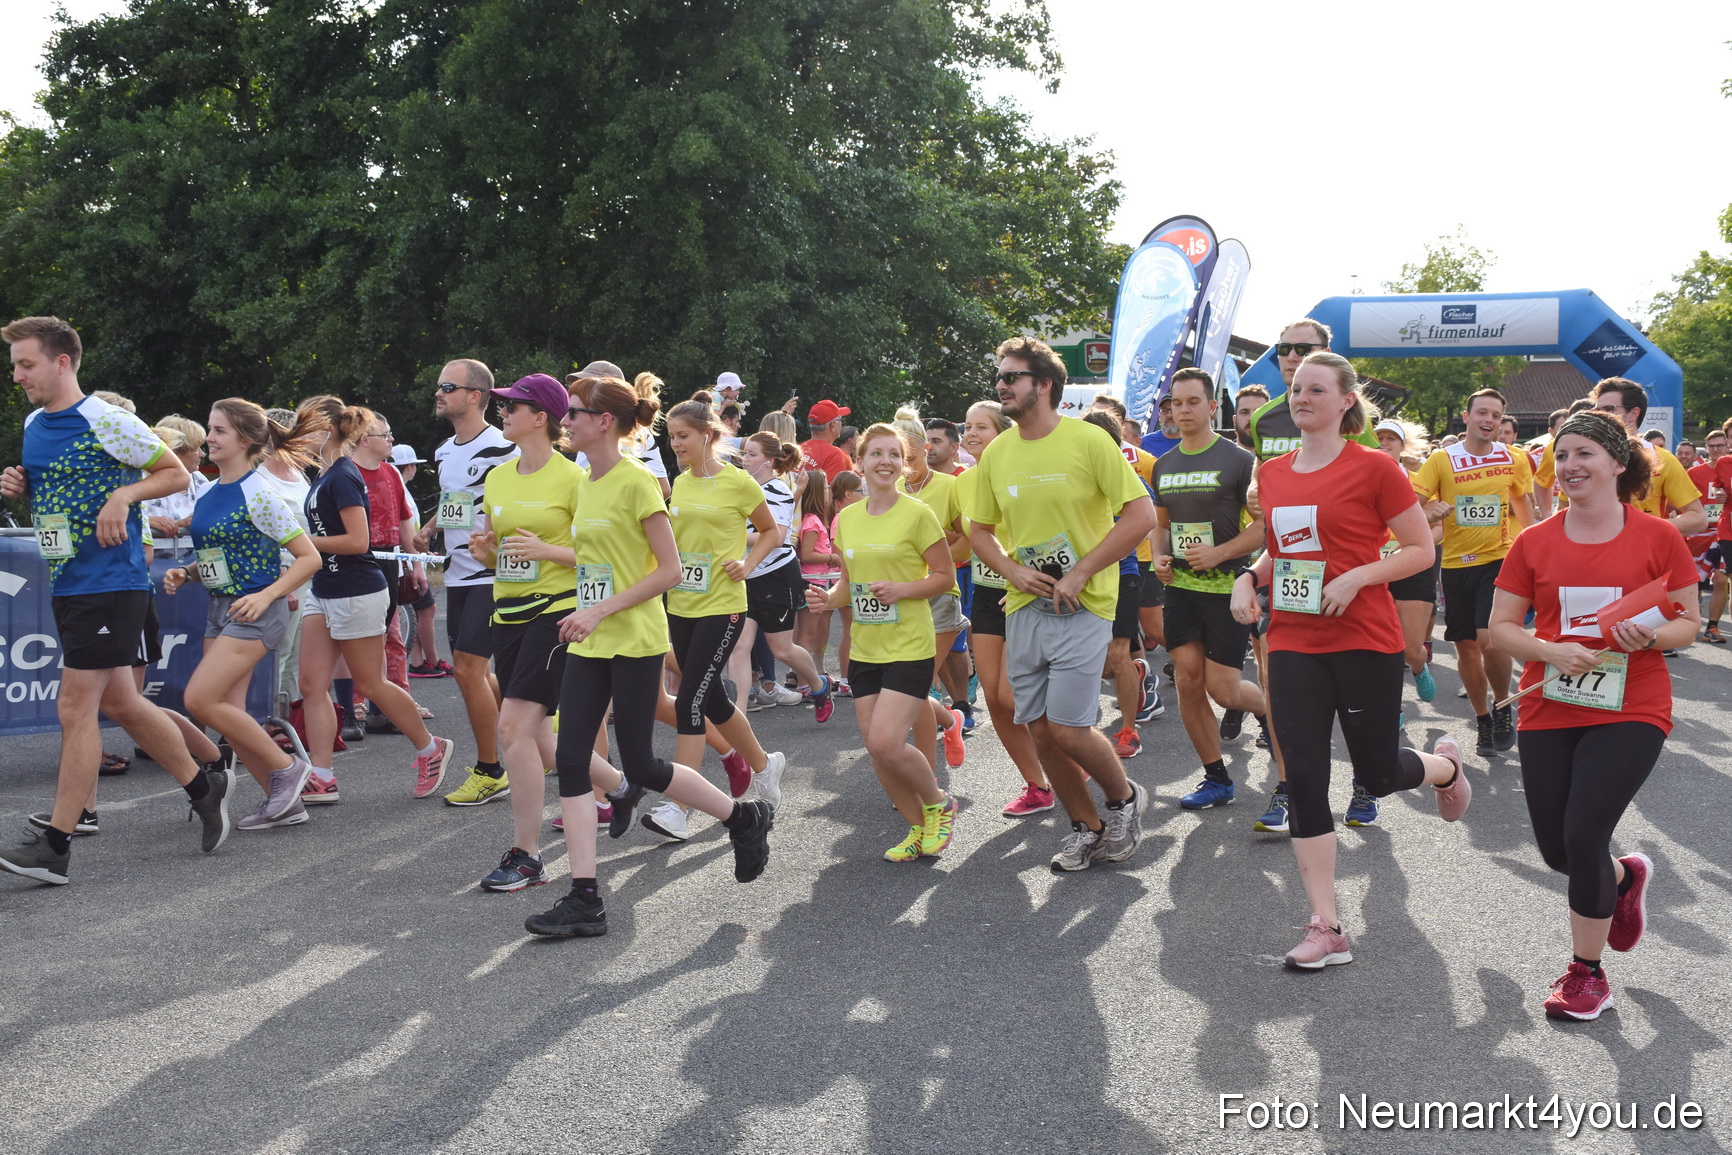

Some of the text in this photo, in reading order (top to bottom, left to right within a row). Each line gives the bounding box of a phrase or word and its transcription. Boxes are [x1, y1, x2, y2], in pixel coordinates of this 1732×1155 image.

[1448, 309, 1475, 318] Fischer
[1428, 324, 1506, 339] firmenlauf
[1262, 439, 1303, 452] BOC
[1159, 472, 1217, 488] BOCK
[1454, 467, 1514, 484] MAX BÖGL
[444, 505, 463, 518] 804
[1461, 506, 1495, 518] 1632
[39, 530, 58, 547] 257
[1288, 532, 1303, 543] DEHN
[199, 563, 217, 578] 221
[579, 582, 606, 600] 1217
[1282, 578, 1310, 598] 535
[691, 622, 736, 727] SUPERDRY SPORT
[1559, 670, 1606, 692] 477
[1557, 686, 1606, 699] Dotzer Susanne
